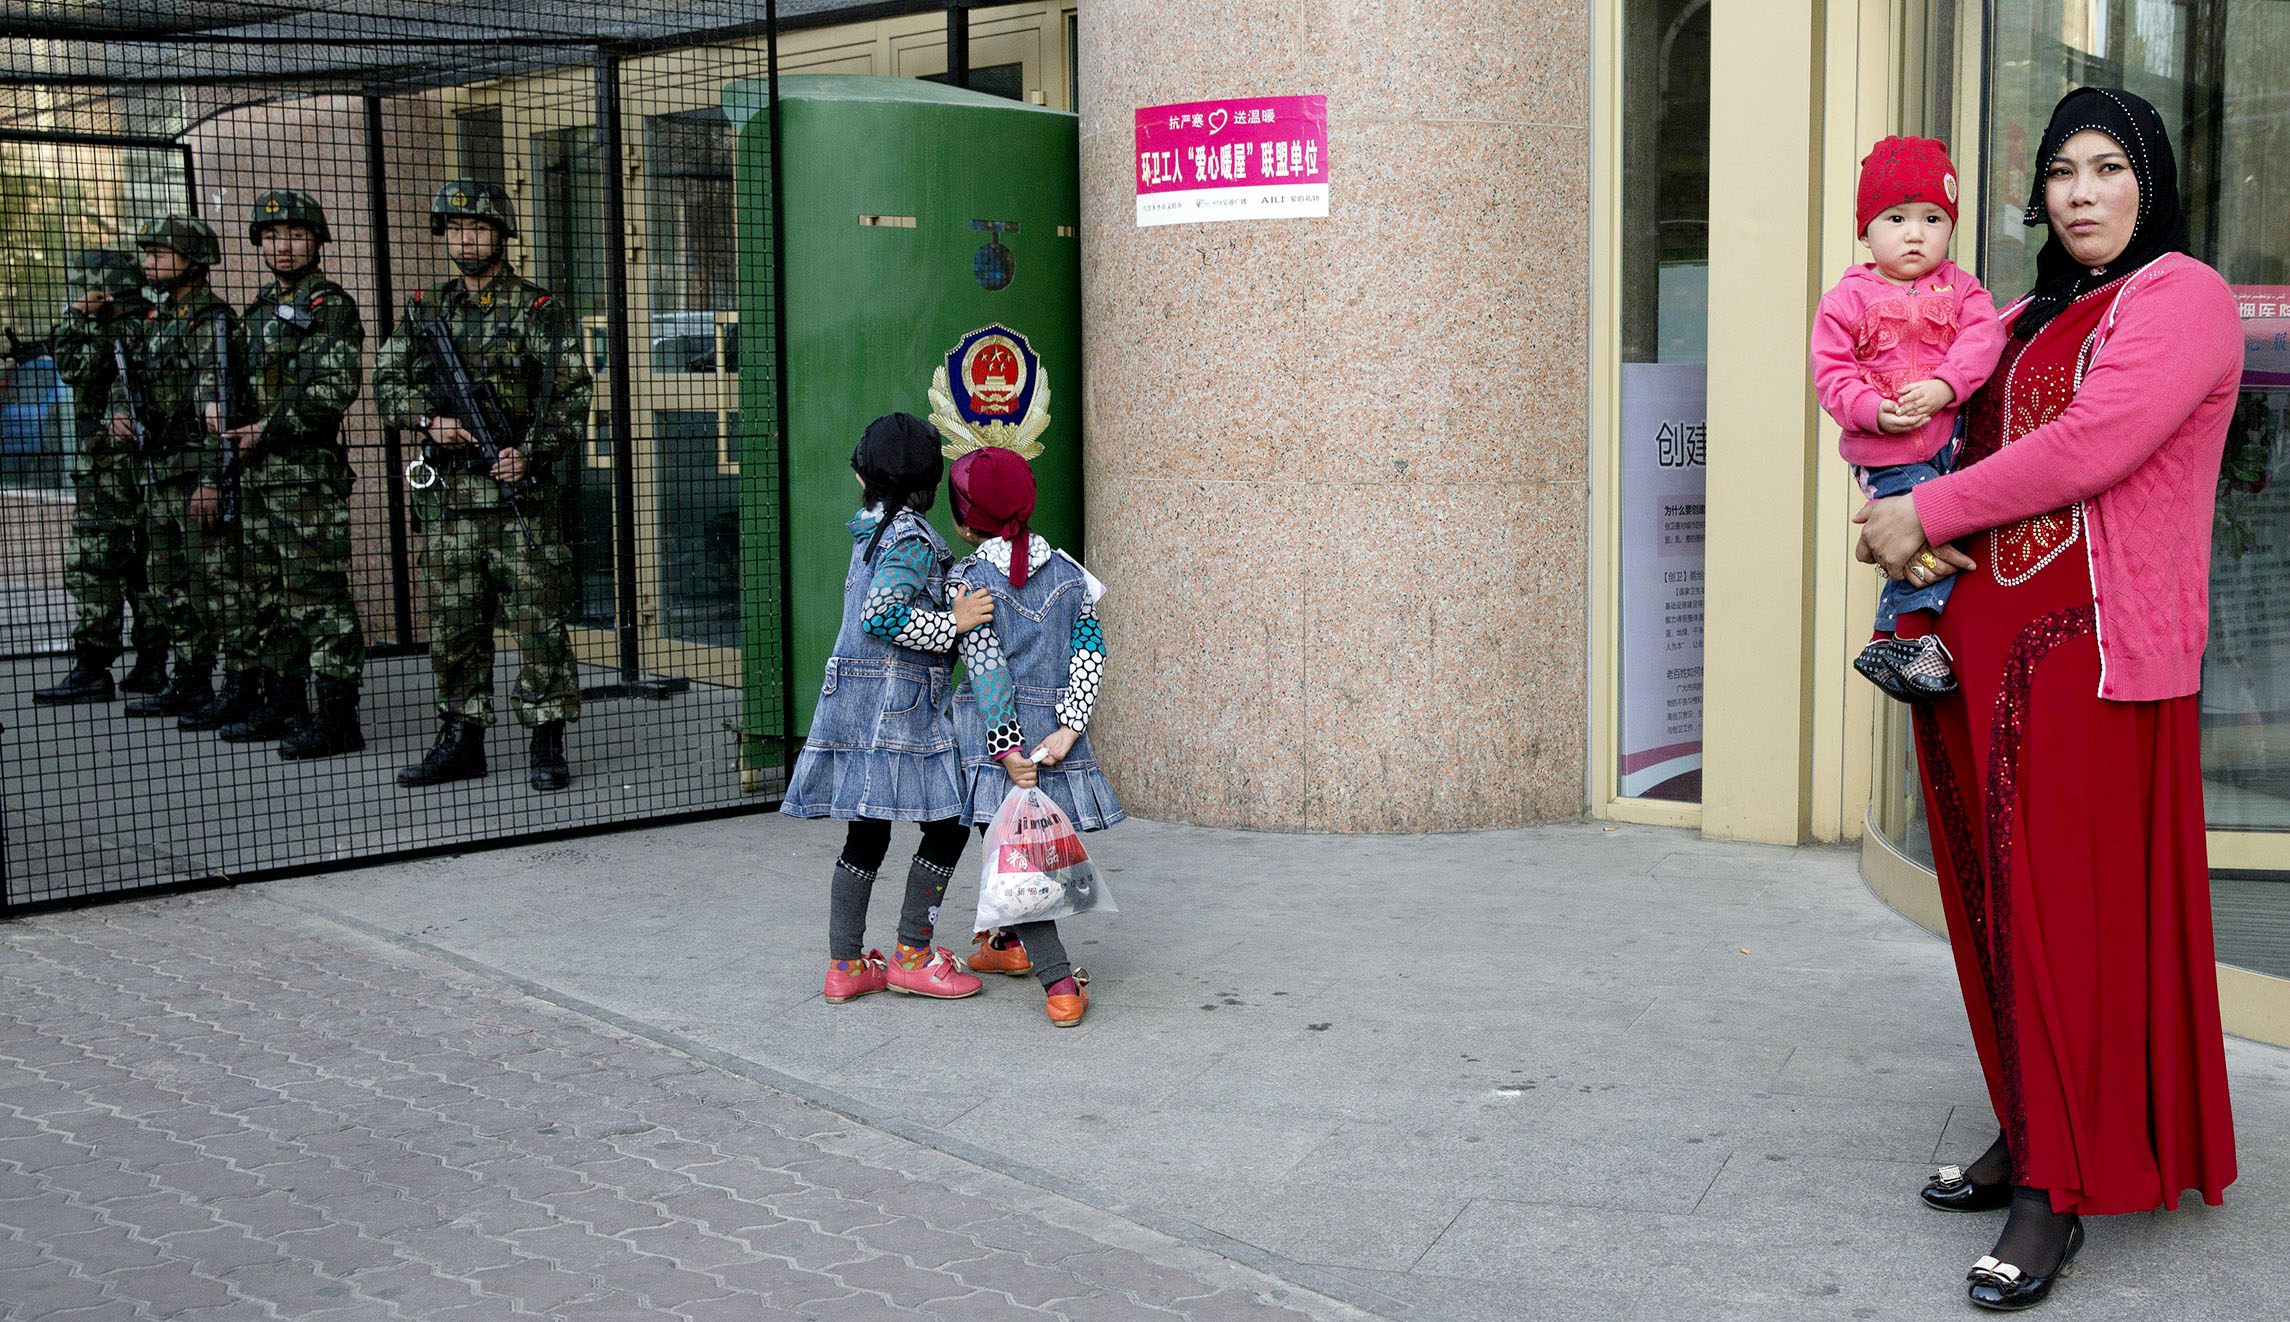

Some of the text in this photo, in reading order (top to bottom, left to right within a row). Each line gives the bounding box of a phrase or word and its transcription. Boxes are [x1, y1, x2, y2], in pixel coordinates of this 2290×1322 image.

[1169, 108, 1276, 130] 抗严寒 送温暖
[1655, 422, 1706, 468] 创建
